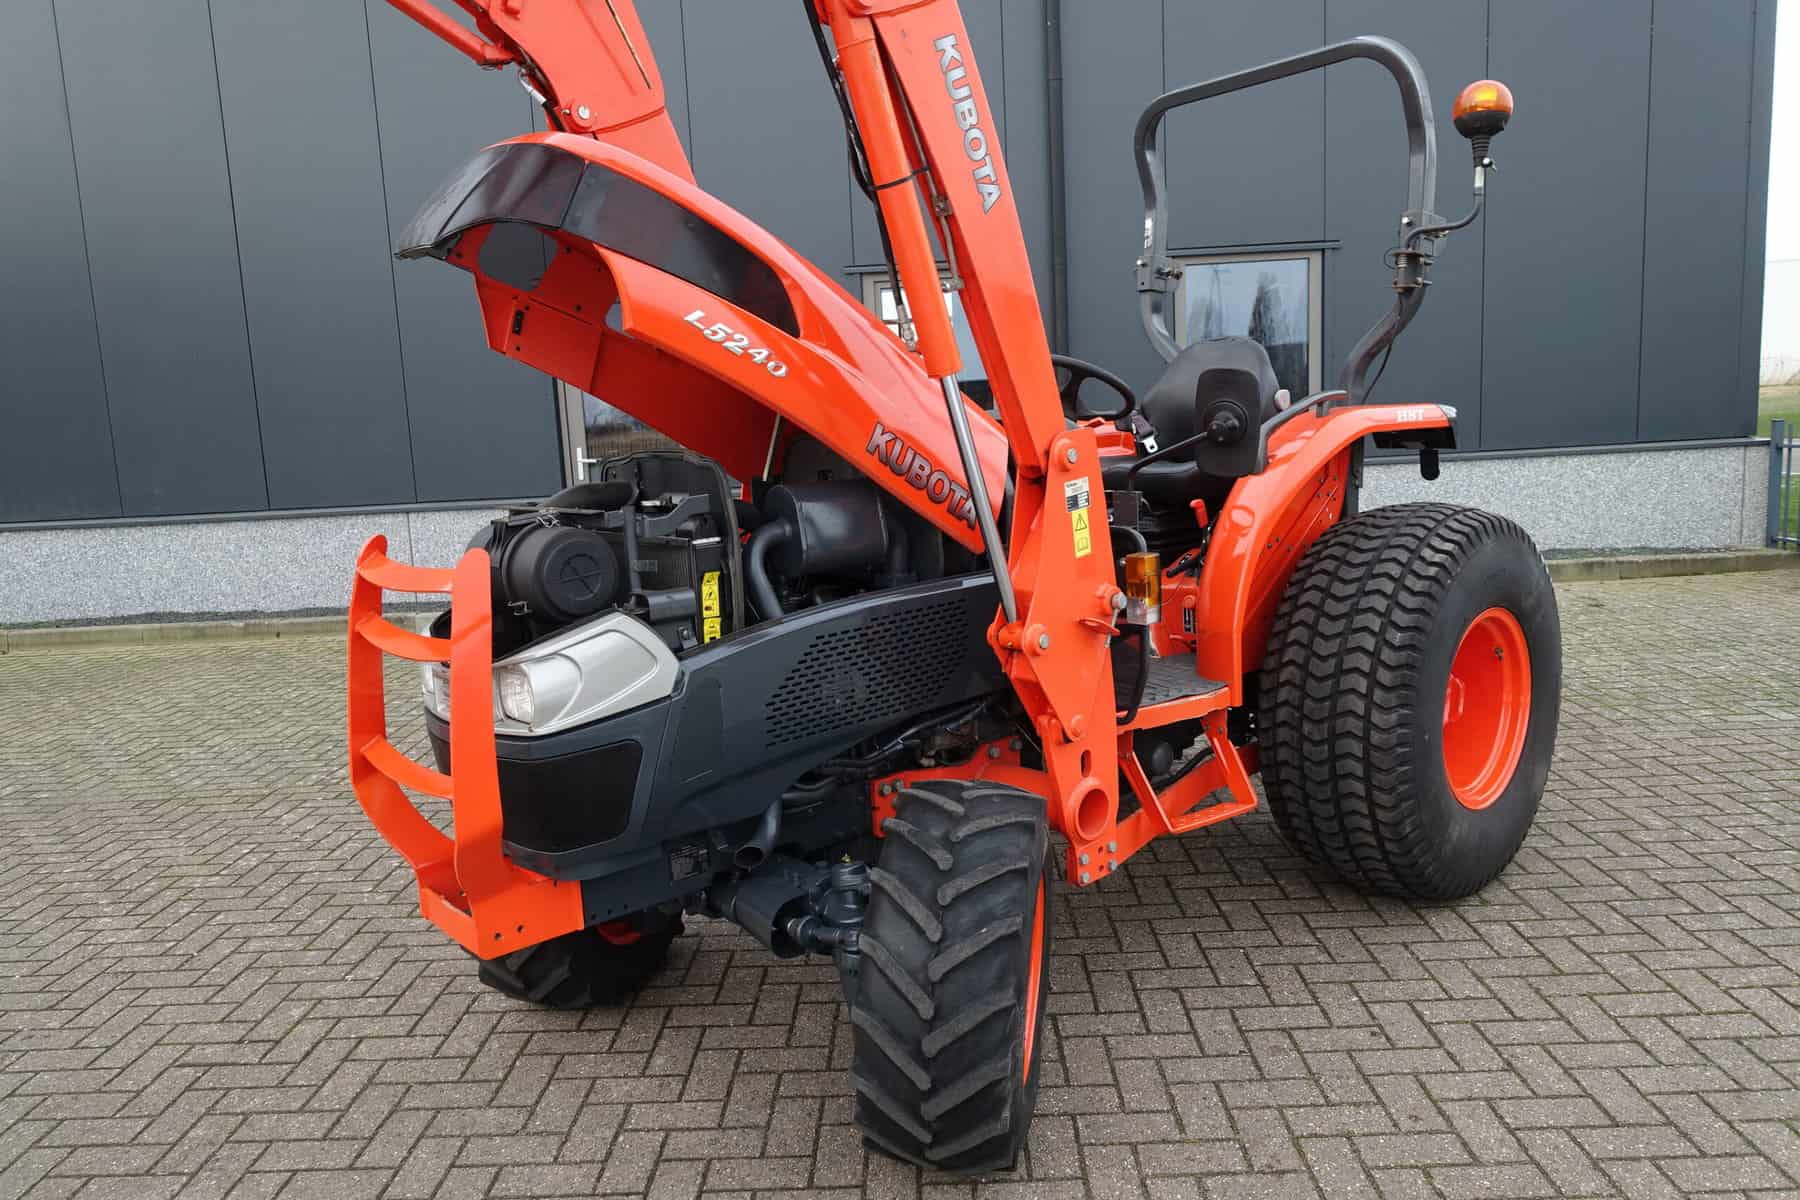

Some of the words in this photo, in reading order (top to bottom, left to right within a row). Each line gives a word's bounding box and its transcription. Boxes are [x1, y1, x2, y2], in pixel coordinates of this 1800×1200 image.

[933, 33, 1002, 215] KUBOTA
[683, 309, 789, 378] L5240
[866, 423, 977, 531] KUBOTA
